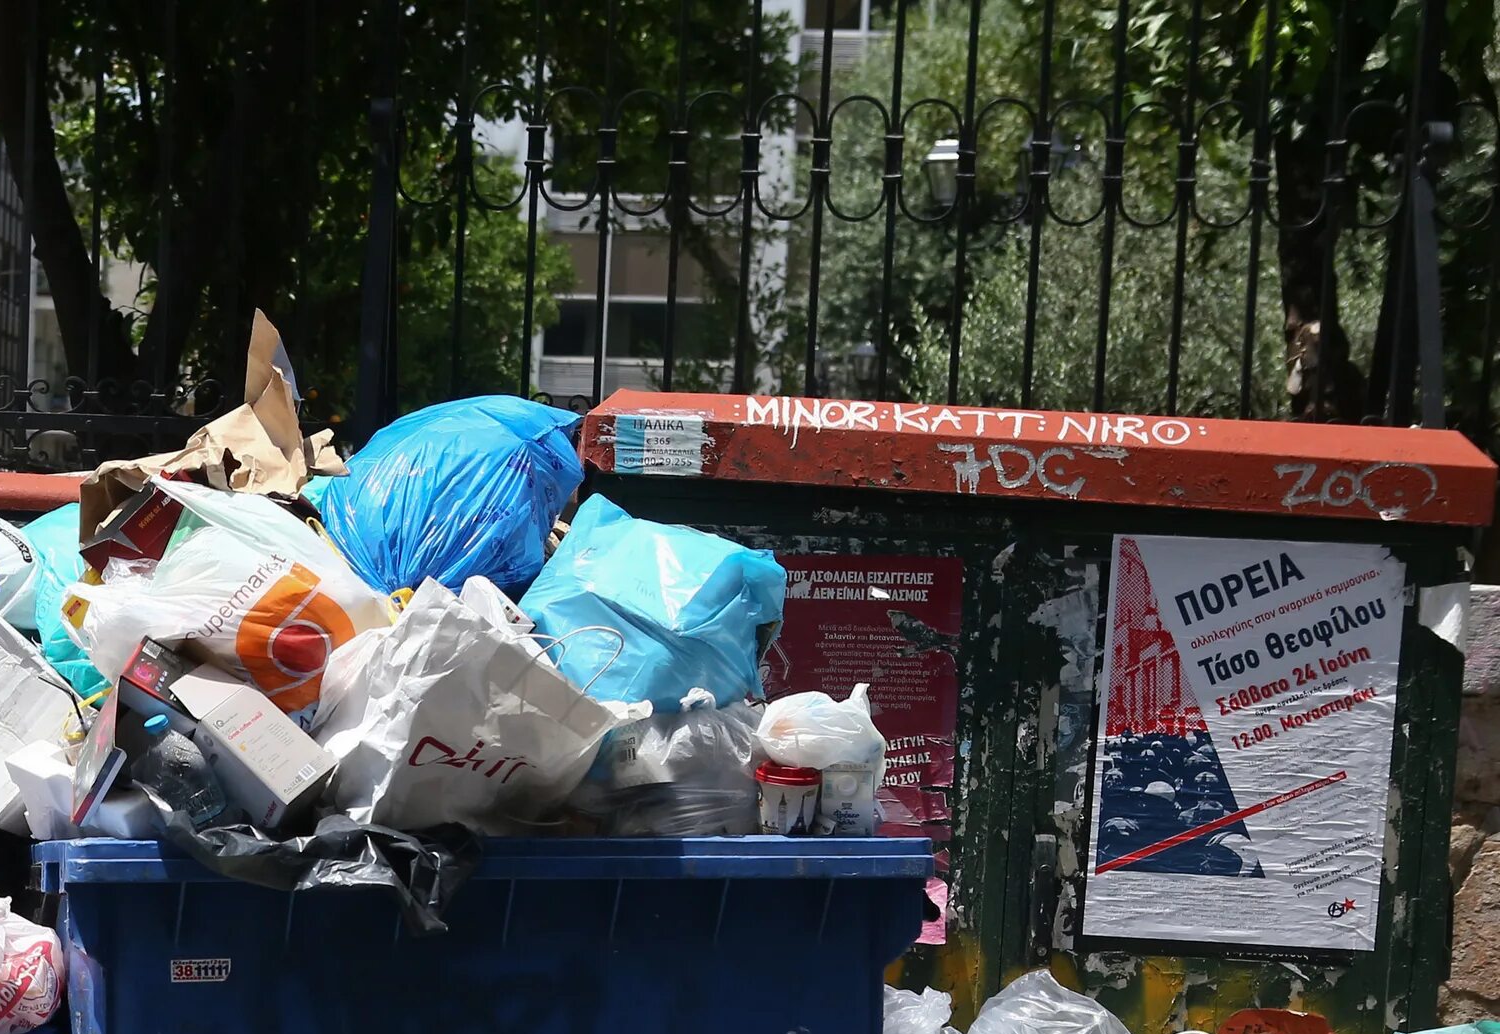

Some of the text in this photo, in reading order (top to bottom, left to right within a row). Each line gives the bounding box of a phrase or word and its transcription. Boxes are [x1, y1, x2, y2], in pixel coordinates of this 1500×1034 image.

[654, 437, 671, 445] 365
[810, 570, 865, 585] ΑΣΦΑΛΕΙΑ
[867, 571, 934, 585] ΕΙΣΑΓΓΕΛΕΙΣ
[1175, 553, 1305, 626] ΠΟΡΕΙΑ
[1255, 609, 1277, 625] στον
[1278, 590, 1323, 615] αναρχικό
[1325, 569, 1382, 598] κομμουνισ
[1198, 649, 1260, 685] Τάσο
[1215, 645, 1373, 716] Σάββατο 24 Ιούνη
[1280, 685, 1378, 733] Μοναστηράκι
[885, 735, 926, 752] ΛΕΓΓΥΗ
